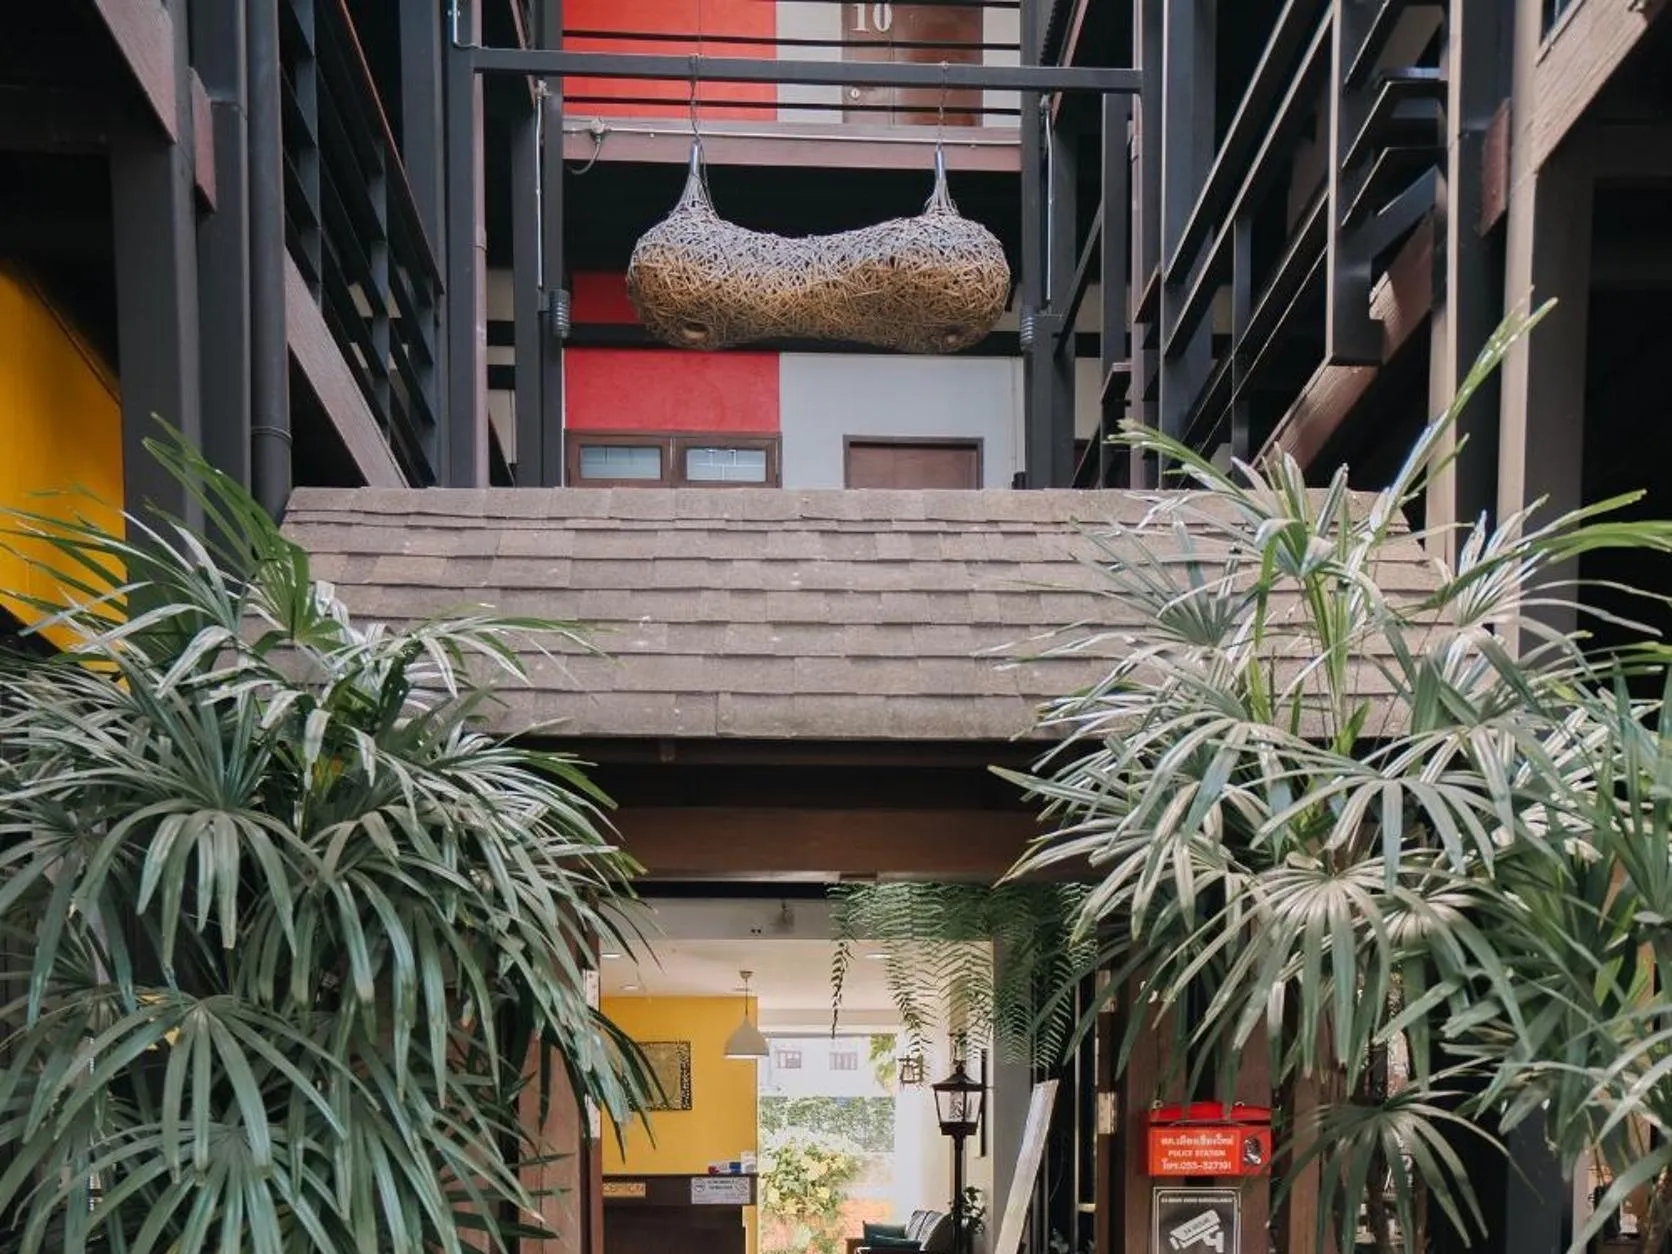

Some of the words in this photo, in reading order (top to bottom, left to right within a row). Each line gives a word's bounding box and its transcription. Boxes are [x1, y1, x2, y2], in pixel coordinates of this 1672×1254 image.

[851, 3, 893, 33] 10
[1168, 1149, 1193, 1157] POLICE
[1195, 1149, 1226, 1157] STATION
